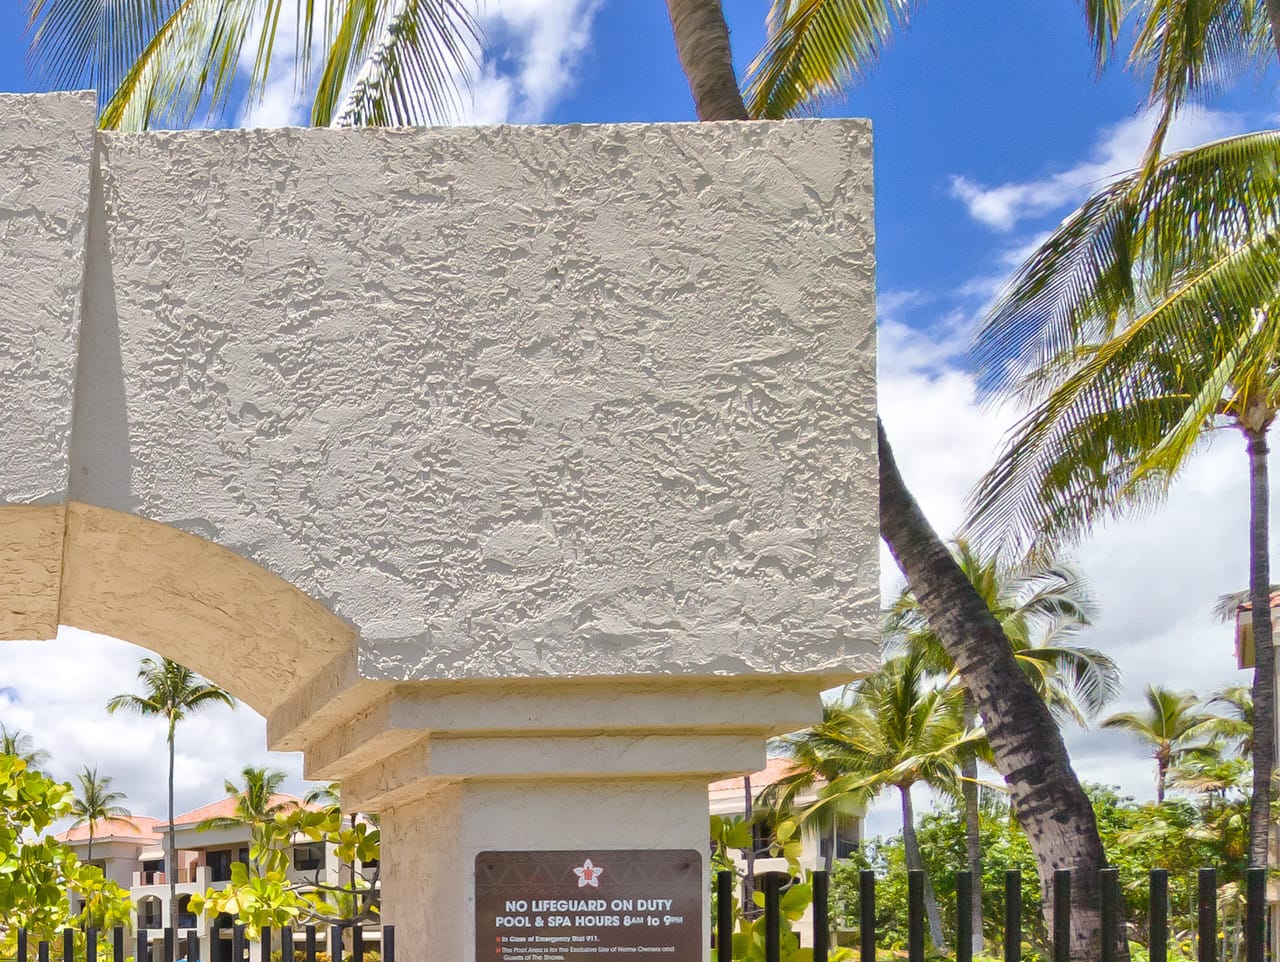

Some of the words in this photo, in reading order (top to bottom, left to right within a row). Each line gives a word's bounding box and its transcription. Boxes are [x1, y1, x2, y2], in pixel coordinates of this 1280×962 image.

[505, 900, 527, 912] NO
[532, 900, 607, 912] LIFEGUARD
[611, 900, 632, 911] ON
[637, 899, 672, 911] DUTY
[495, 916, 531, 927] POOL
[535, 916, 544, 927] &
[548, 916, 571, 927] SPA
[575, 916, 620, 927] HOURS
[624, 916, 643, 927] 8AM
[647, 916, 660, 927] to
